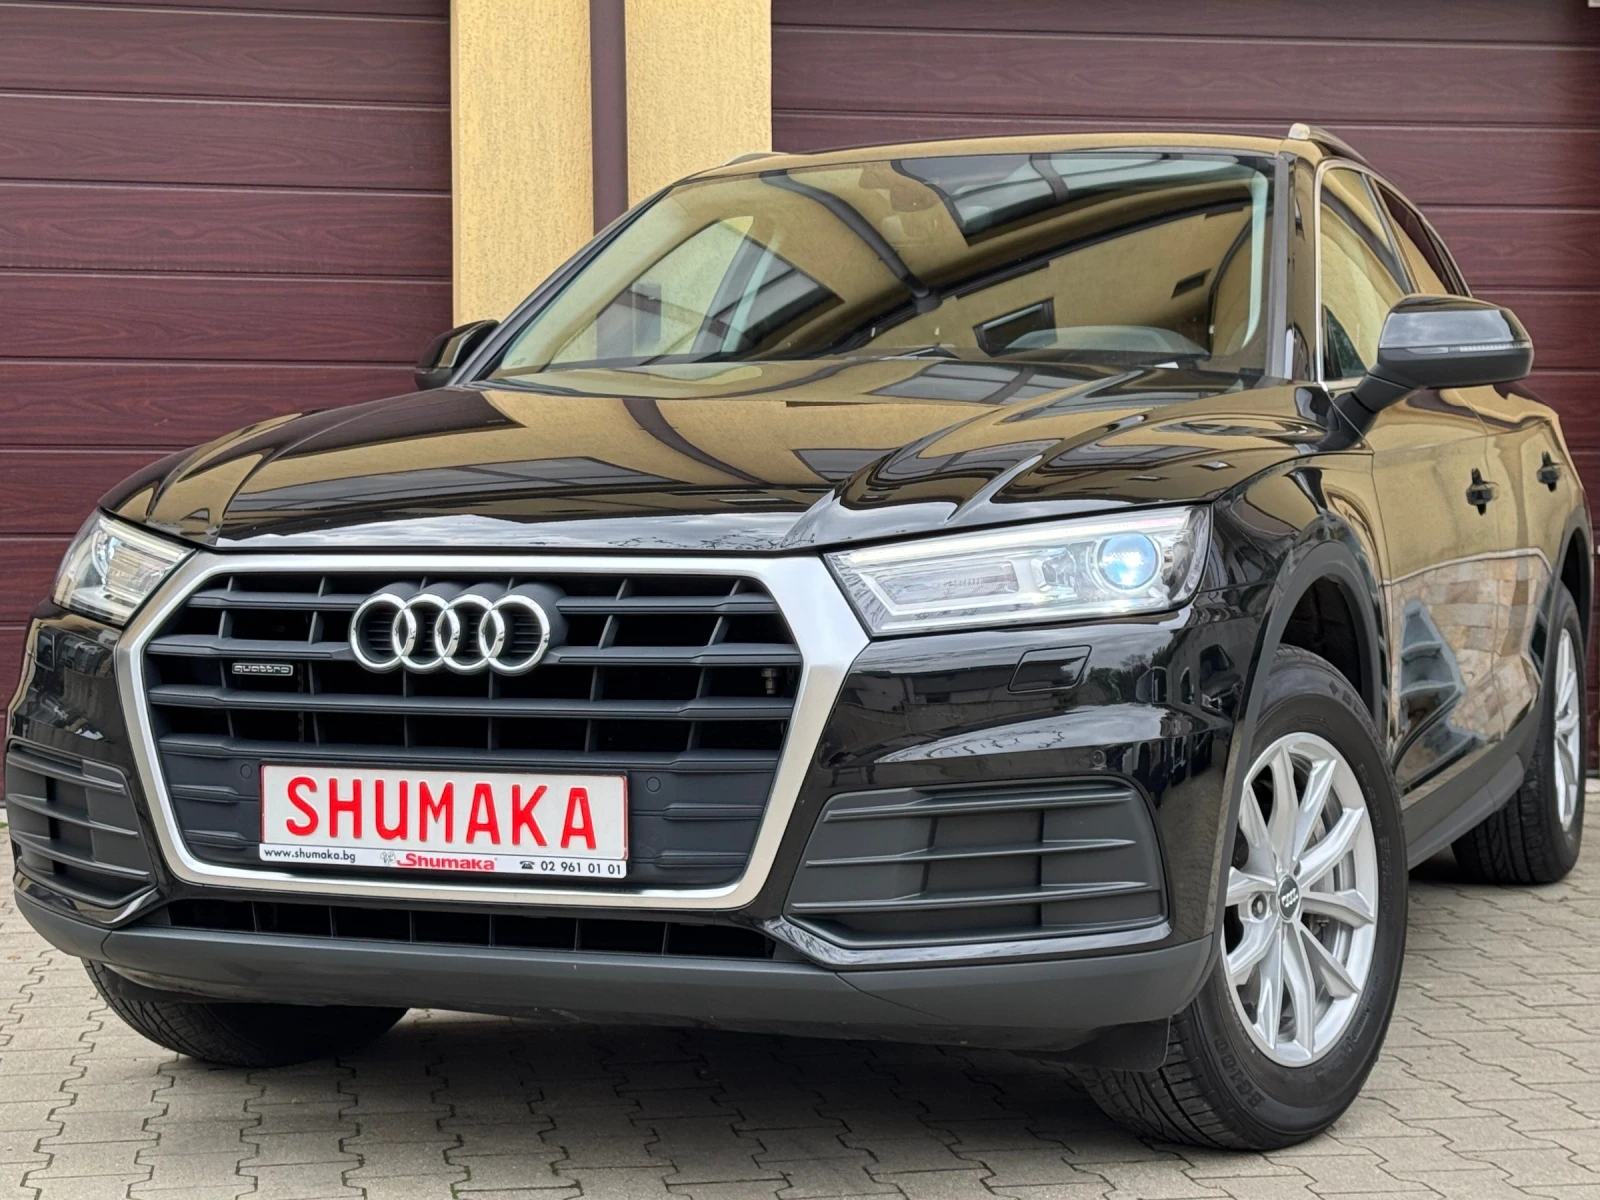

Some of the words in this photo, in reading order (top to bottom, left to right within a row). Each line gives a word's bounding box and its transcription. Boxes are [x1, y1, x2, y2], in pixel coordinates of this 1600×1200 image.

[233, 664, 291, 674] quattro
[286, 776, 597, 849] SHUMAKA
[264, 848, 356, 864] www.shumaka.bg
[396, 852, 496, 872] Shumaka
[540, 861, 555, 872] 02
[560, 862, 581, 873] 961
[587, 863, 601, 874] 01
[607, 864, 621, 875] 01
